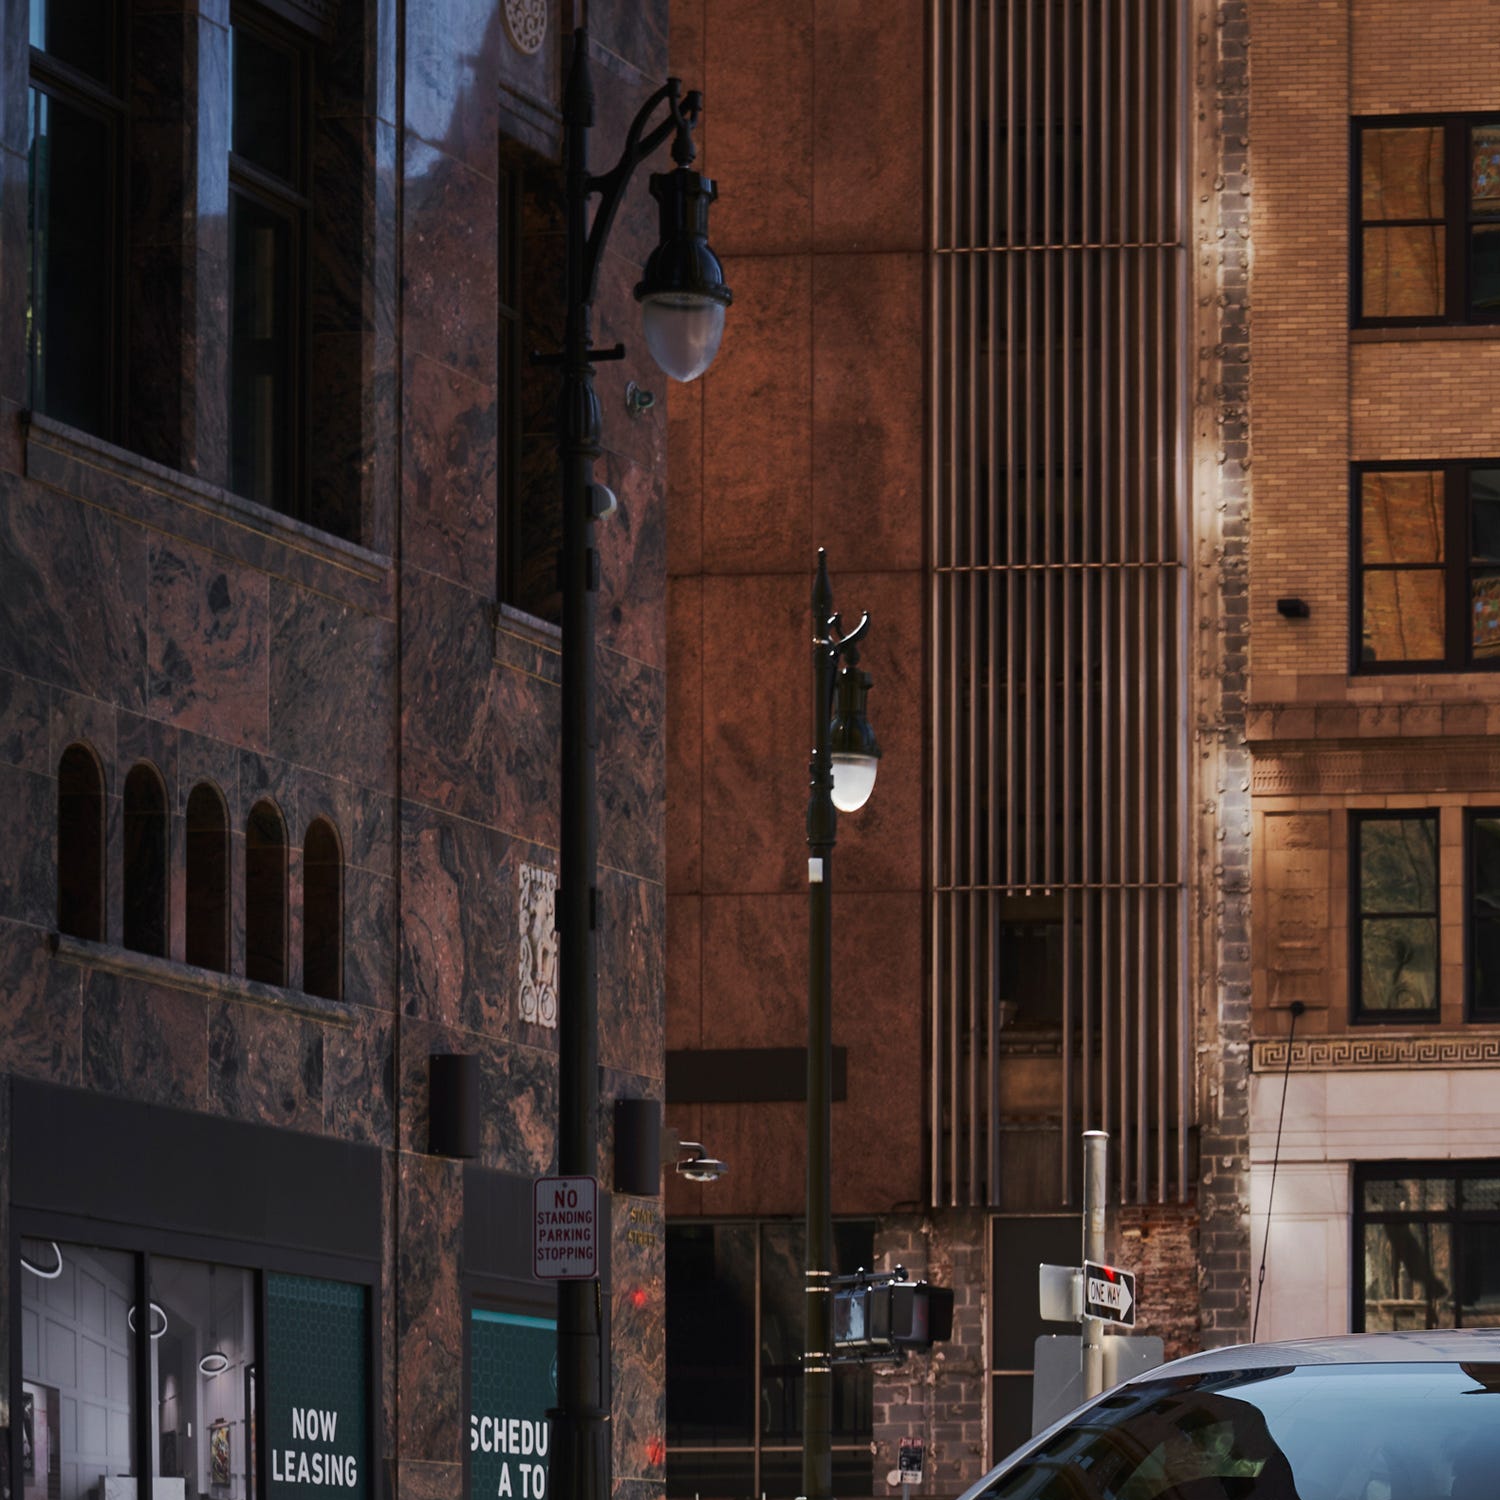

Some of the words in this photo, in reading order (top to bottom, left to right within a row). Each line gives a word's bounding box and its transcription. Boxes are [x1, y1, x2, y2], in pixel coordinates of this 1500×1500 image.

[554, 1189, 578, 1209] NO
[538, 1210, 593, 1225] STANDING
[539, 1228, 591, 1242] PARKING
[537, 1246, 593, 1260] STOPPING
[1091, 1281, 1105, 1302] ONE
[1107, 1285, 1120, 1304] WAY
[292, 1407, 337, 1442] NOW
[272, 1449, 357, 1488] LEASING
[498, 1462, 512, 1498] A
[519, 1463, 549, 1500] TO
